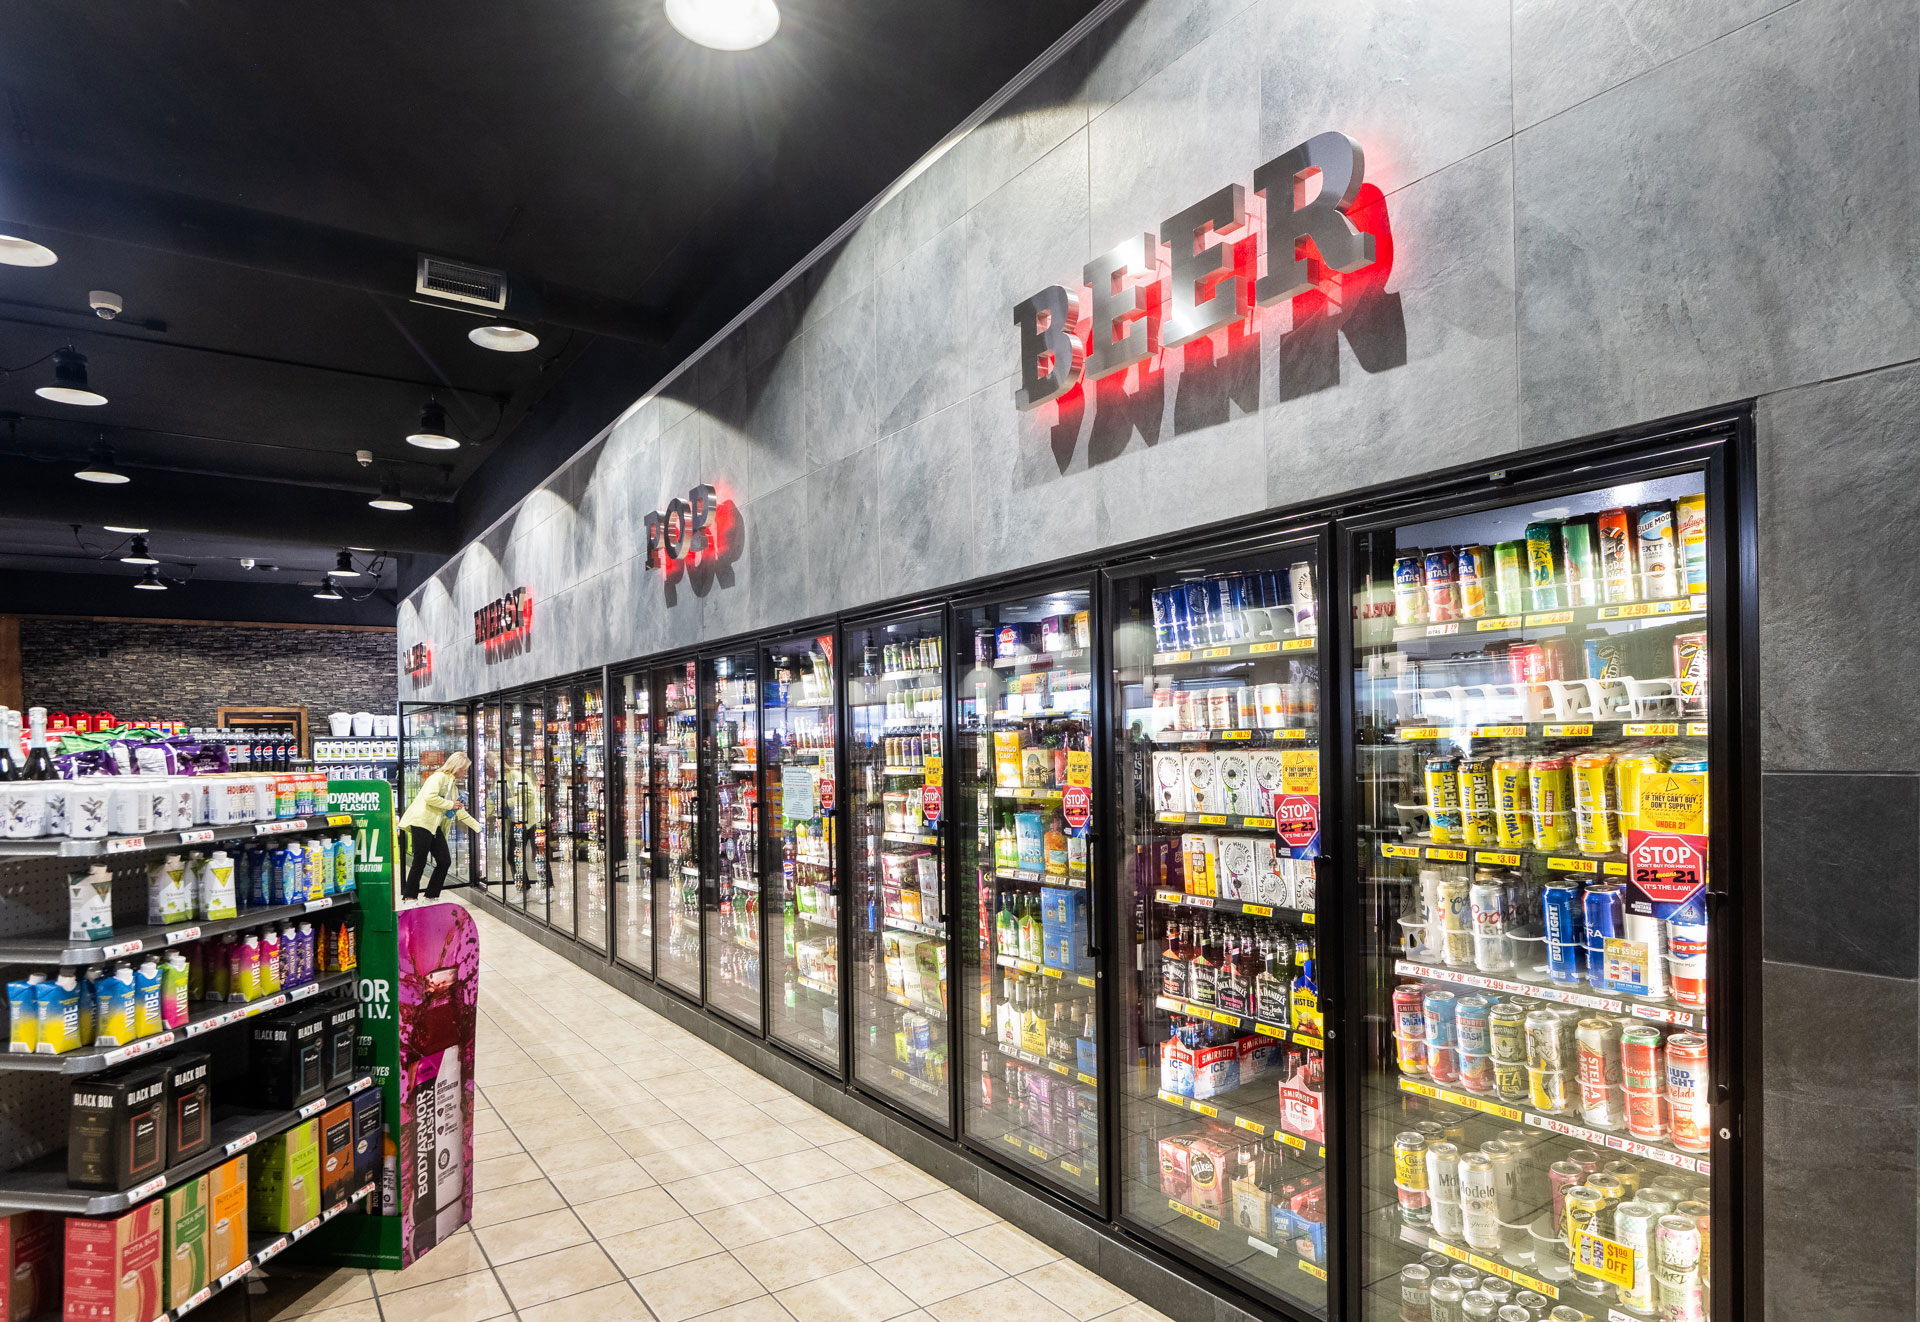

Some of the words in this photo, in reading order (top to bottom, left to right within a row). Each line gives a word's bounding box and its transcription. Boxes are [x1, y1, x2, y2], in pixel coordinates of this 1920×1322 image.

[1013, 131, 1376, 411] BEER
[644, 484, 716, 571] POP
[1637, 522, 1653, 534] BLUE
[1397, 574, 1420, 584] RITAS
[474, 586, 526, 645] ENERGY
[1624, 604, 1649, 616] $2.99
[1296, 639, 1313, 648] $2.99
[1419, 728, 1439, 738] $2.09
[1503, 726, 1525, 736] $2.09
[1566, 725, 1589, 735] $2.09
[1649, 724, 1675, 734] $2.09
[996, 745, 1017, 753] MANGO
[999, 752, 1015, 760] CART
[1503, 775, 1517, 794] TEA
[1532, 776, 1542, 792] TEA
[924, 792, 938, 801] STOP
[1066, 794, 1085, 805] STOP
[1443, 774, 1459, 832] EXTREME
[1667, 795, 1683, 803] CAN'T
[340, 803, 367, 811] FLASH
[1280, 804, 1310, 818] STOP
[1473, 775, 1490, 836] EXTREME
[1650, 801, 1668, 809] DON'T
[1668, 802, 1693, 811] SUPPLY!
[1502, 794, 1522, 839] TWISTED
[1280, 823, 1295, 833] 21
[1301, 821, 1316, 831] 21
[1655, 820, 1677, 829] UNDER
[1678, 822, 1686, 830] 21
[1232, 841, 1249, 855] WHITE
[1399, 846, 1416, 856] $3.19
[1446, 850, 1464, 860] $3.19
[1638, 846, 1691, 864] STOP
[1497, 854, 1517, 865] $3.19
[1570, 861, 1593, 872] $3.19
[1636, 869, 1661, 883] 21
[1672, 870, 1698, 883] 21
[1550, 905, 1560, 938] LIGHT
[1551, 938, 1563, 962] BUD
[1621, 947, 1630, 955] $5
[1631, 949, 1644, 957] OFF
[1483, 978, 1504, 990] $2.99
[1263, 987, 1287, 1006] DANIEL'S
[368, 1004, 391, 1019] I.V.
[1599, 1000, 1610, 1011] $2
[332, 1011, 346, 1026] BLACK
[347, 1008, 356, 1020] BOX
[1665, 1010, 1676, 1024] 3
[1678, 1012, 1691, 1022] 19
[254, 1030, 273, 1041] BLACK
[274, 1030, 287, 1041] BOX
[298, 1025, 312, 1039] BLACK
[313, 1020, 323, 1034] BOX
[1268, 1027, 1285, 1038] $10.29
[1242, 1036, 1274, 1051] SMIRNOFF
[1201, 1048, 1234, 1064] SMIRNOFF
[1251, 1047, 1266, 1061] ICE
[1169, 1059, 1183, 1070] ICE
[1210, 1060, 1225, 1074] ICE
[174, 1070, 194, 1087] BLACK
[195, 1064, 207, 1078] BOX
[1497, 1072, 1522, 1087] TEA
[1588, 1056, 1600, 1099] STELLA
[127, 1086, 149, 1106] BLACK
[150, 1081, 163, 1096] BOX
[427, 1085, 435, 1107] I.V.
[1283, 1089, 1314, 1105] SMIRNOFF
[1419, 1085, 1436, 1098] $3.19
[74, 1093, 96, 1107] BLACK
[97, 1095, 113, 1108] BOX
[1459, 1096, 1478, 1109] $3.19
[1290, 1101, 1308, 1116] ICE
[1498, 1106, 1518, 1120] $3.19
[427, 1107, 435, 1152] FLASH
[1547, 1120, 1570, 1135] $3.29
[1287, 1136, 1305, 1149] $10.29
[1582, 1129, 1593, 1142] $2
[416, 1089, 429, 1199] BODYARMOR
[1626, 1141, 1635, 1154] 2
[1636, 1143, 1646, 1153] 99
[1669, 1153, 1683, 1167] $2
[1191, 1159, 1214, 1176] mike's
[177, 1217, 194, 1231] BOTA
[194, 1209, 206, 1222] BOX
[124, 1242, 144, 1257] BOTA
[145, 1234, 158, 1248] BOX
[1448, 1246, 1467, 1261] $3.19
[1490, 1262, 1509, 1278] $3.19
[1606, 1258, 1628, 1275] OFF
[1535, 1280, 1555, 1296] $3.19
